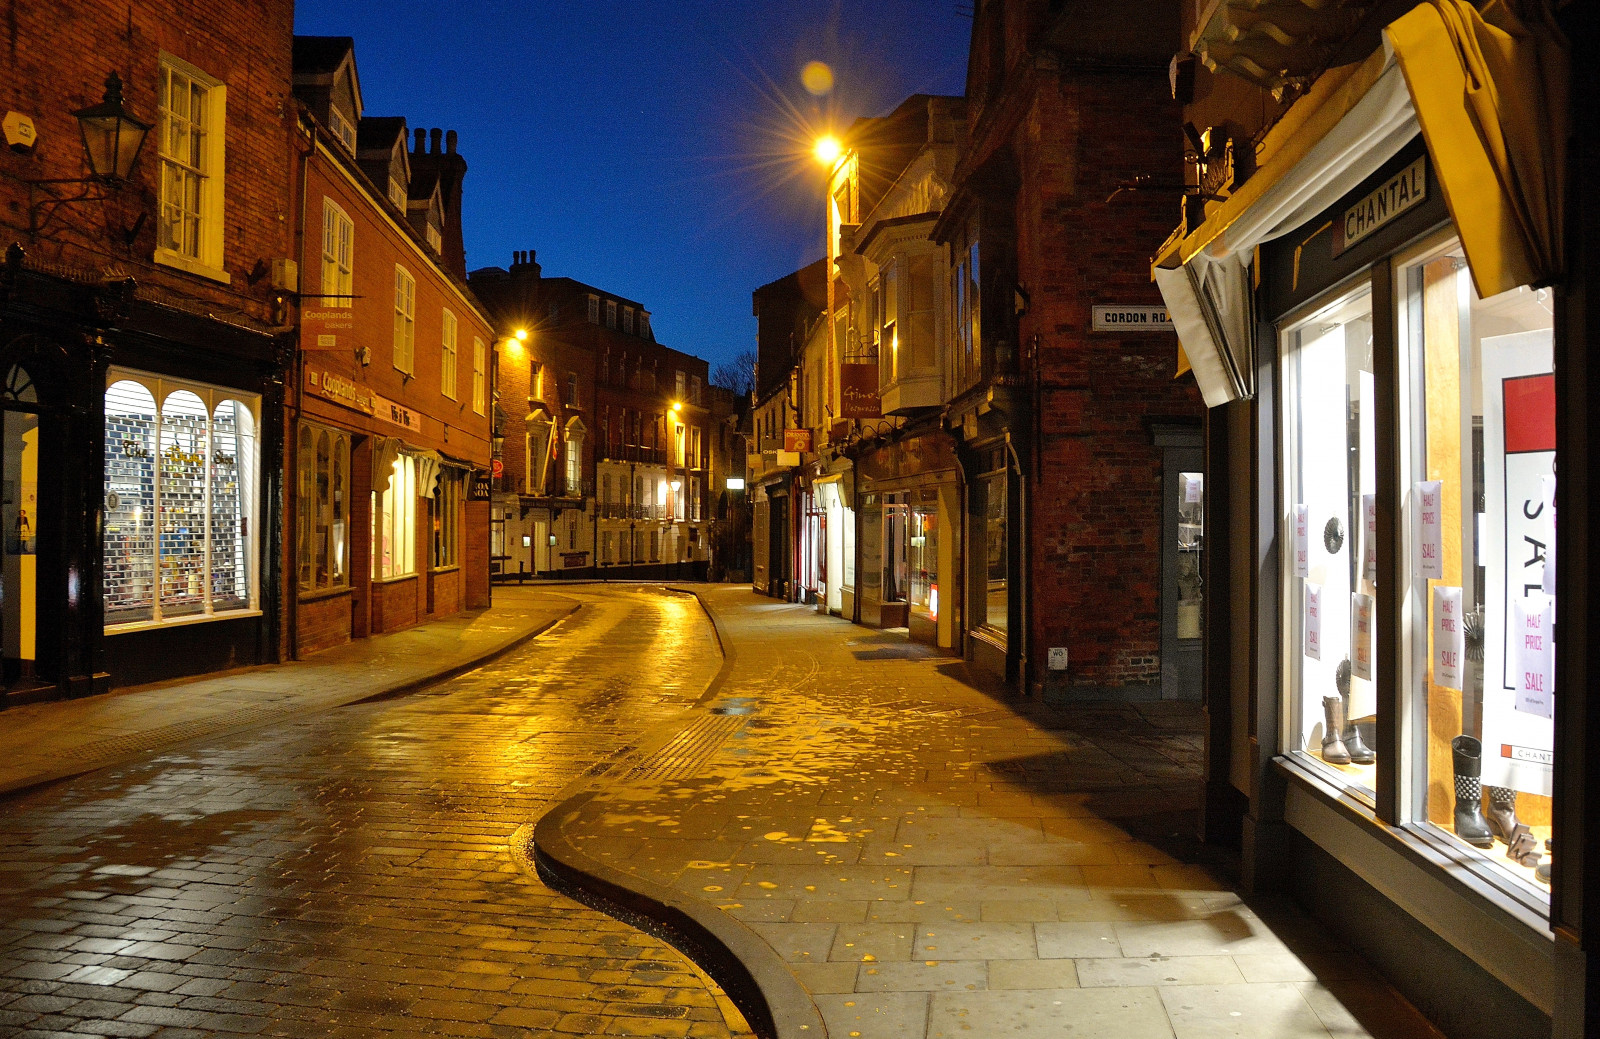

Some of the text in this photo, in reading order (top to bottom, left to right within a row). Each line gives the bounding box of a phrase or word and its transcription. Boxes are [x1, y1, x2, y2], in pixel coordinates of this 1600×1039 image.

[1346, 168, 1420, 239] CHANTAL
[304, 310, 353, 320] Cooplands
[1152, 312, 1166, 323] RO
[321, 371, 356, 400] Cooplands
[1423, 493, 1434, 507] HALF
[1422, 512, 1434, 525] PRICE
[1422, 543, 1435, 559] SALE
[1443, 601, 1454, 613] HALF
[1441, 618, 1456, 632] PRICE
[1526, 614, 1541, 629] HALF
[1525, 635, 1543, 651] PRICE
[1441, 651, 1456, 668] SALE
[1525, 672, 1543, 692] SALE
[1518, 749, 1552, 762] CHANT
